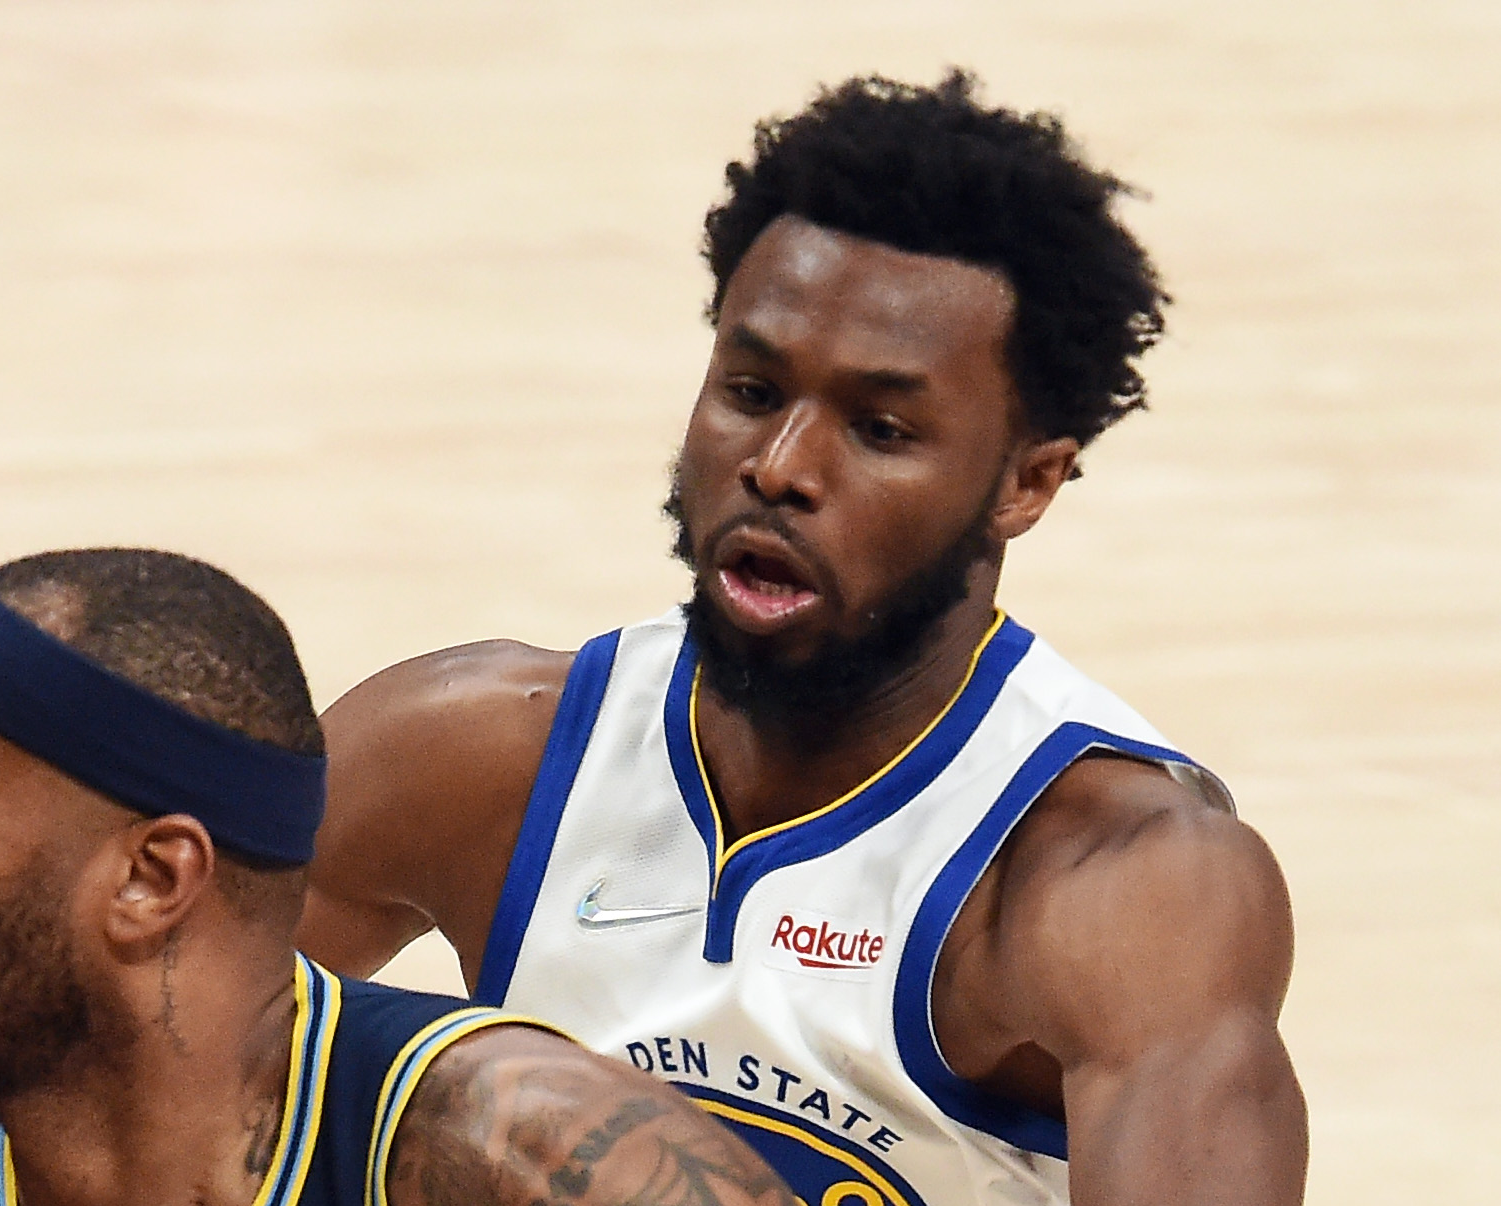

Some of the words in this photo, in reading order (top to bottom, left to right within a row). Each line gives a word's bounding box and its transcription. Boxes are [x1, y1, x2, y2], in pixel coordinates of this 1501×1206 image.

[770, 915, 885, 964] Rakute
[626, 1037, 709, 1078] DEN
[736, 1054, 904, 1153] STATE
